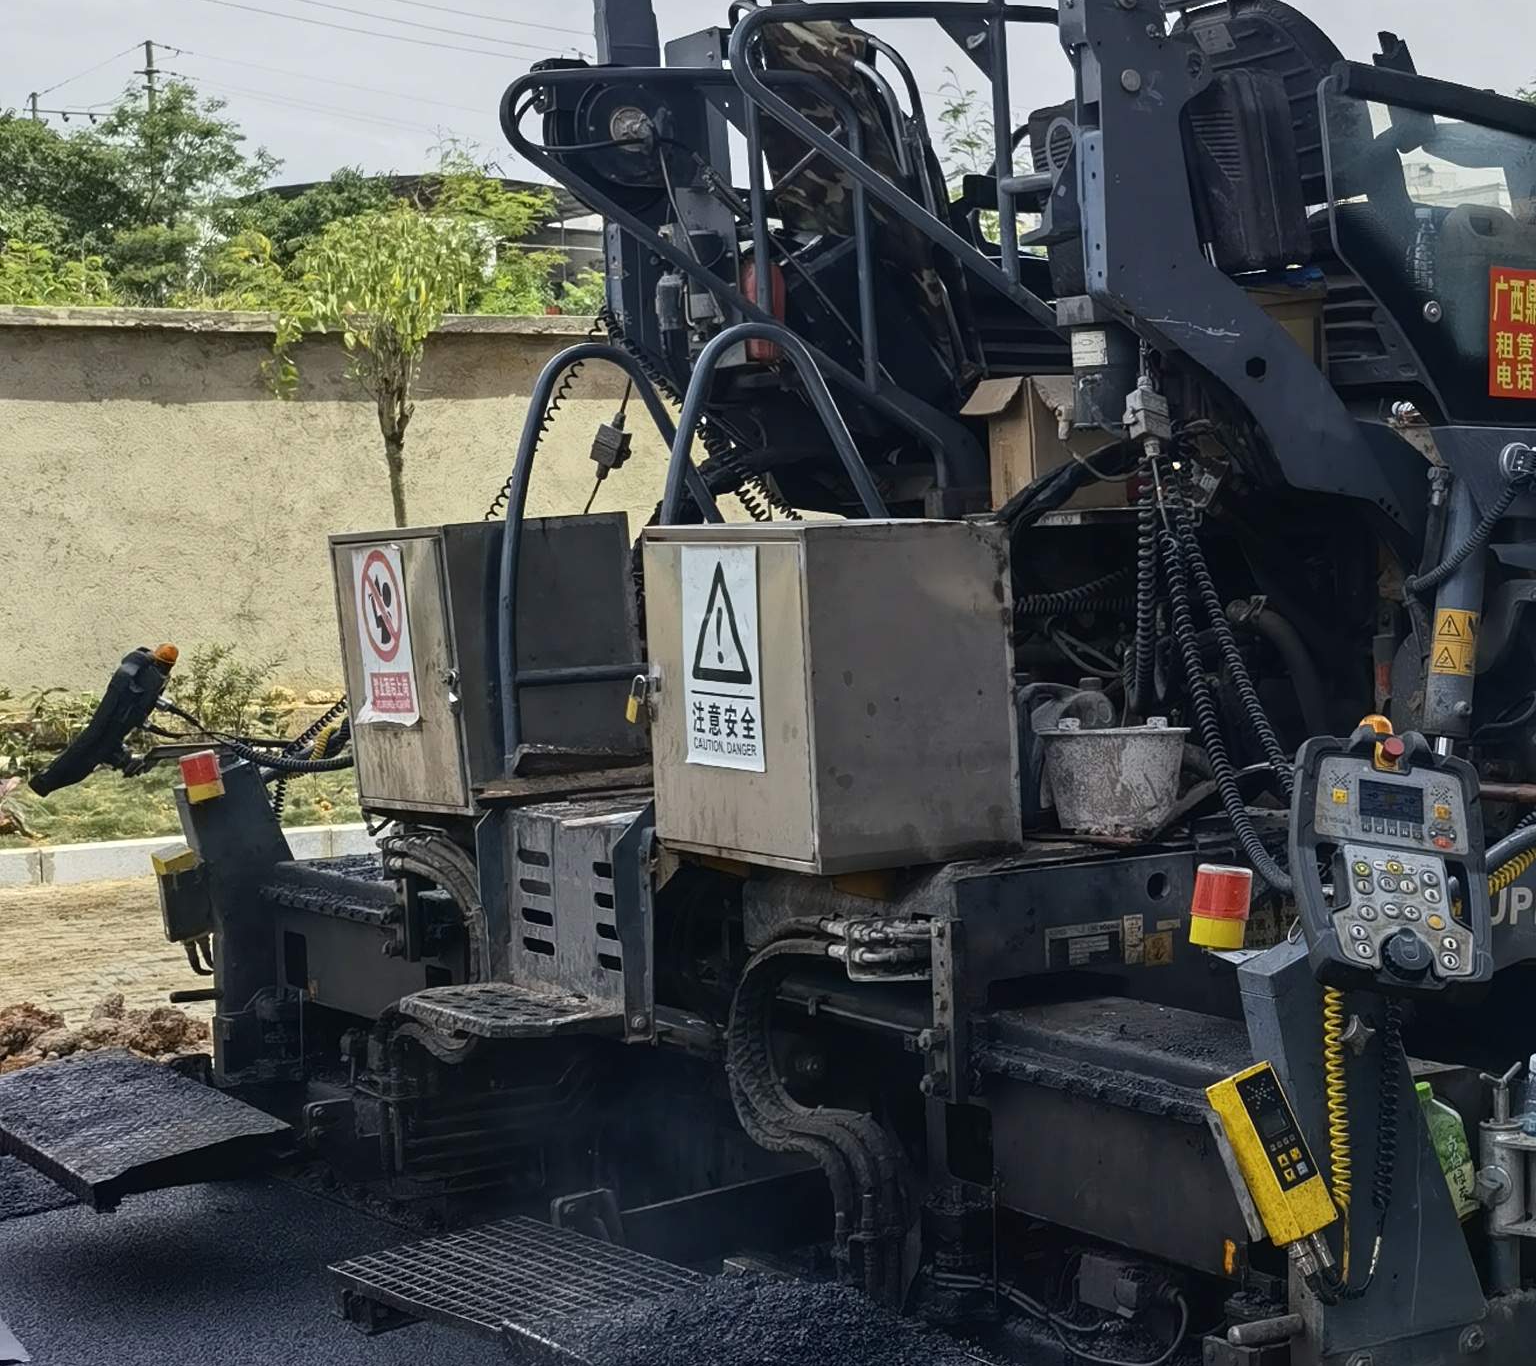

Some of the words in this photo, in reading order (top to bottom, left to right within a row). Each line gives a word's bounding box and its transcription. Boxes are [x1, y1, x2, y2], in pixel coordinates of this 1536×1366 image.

[1496, 331, 1534, 361] 租赁
[1496, 362, 1535, 391] 电话
[692, 701, 756, 740] 注意安全
[727, 741, 757, 757] DANGER
